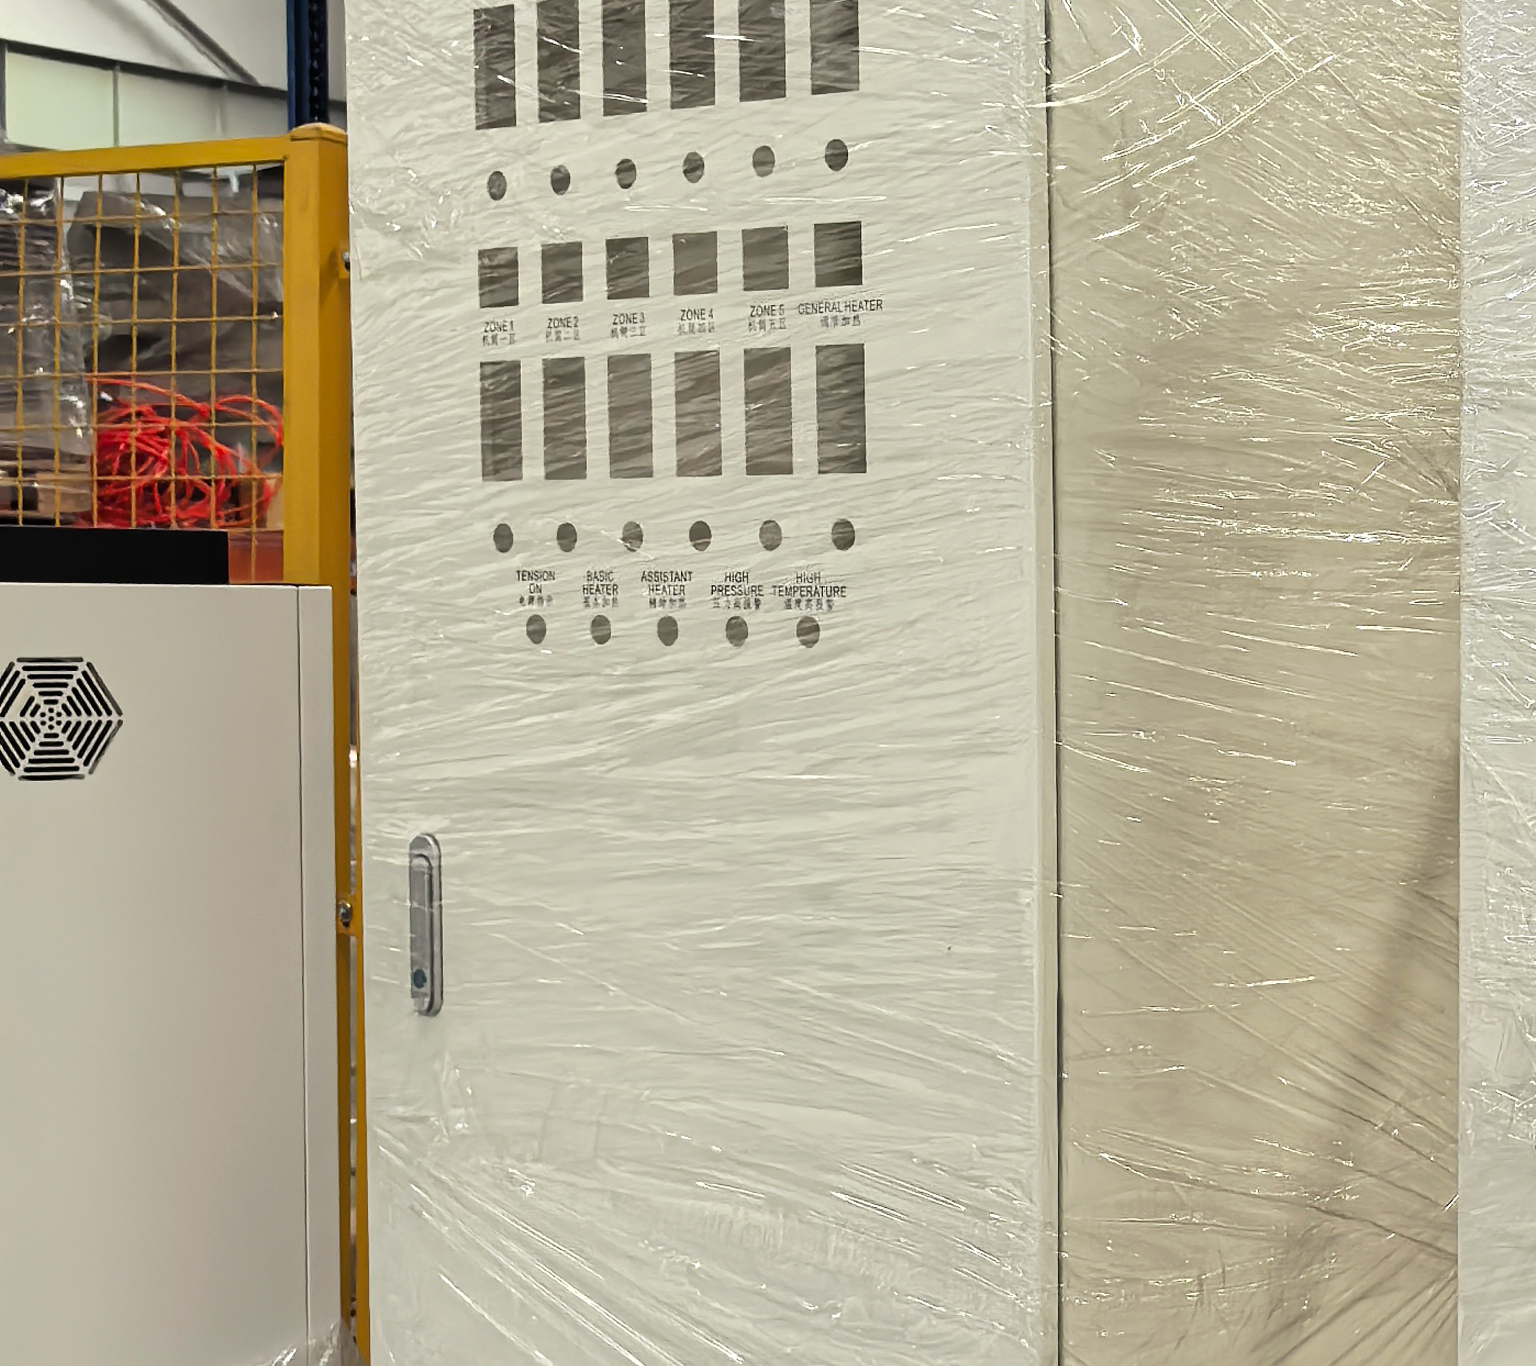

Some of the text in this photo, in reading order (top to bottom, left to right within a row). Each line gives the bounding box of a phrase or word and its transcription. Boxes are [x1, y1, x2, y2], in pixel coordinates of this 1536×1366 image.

[749, 304, 777, 318] ZONE
[797, 299, 883, 315] GENERAL HEATER
[612, 313, 638, 325] ZONE
[680, 308, 707, 321] ZONE
[484, 320, 509, 333] ZONE
[547, 317, 572, 329] ZONE
[516, 570, 556, 582] TENSION
[586, 570, 614, 582] BASIC
[640, 570, 693, 582] ASSISTANT
[724, 571, 749, 583] HIGH
[796, 571, 821, 584] HIGH
[528, 583, 543, 594] ON
[582, 584, 619, 595] HEATER
[648, 584, 686, 596] HEATER
[711, 584, 764, 596] PRESSURE
[772, 585, 847, 598] TEMPERATURE
